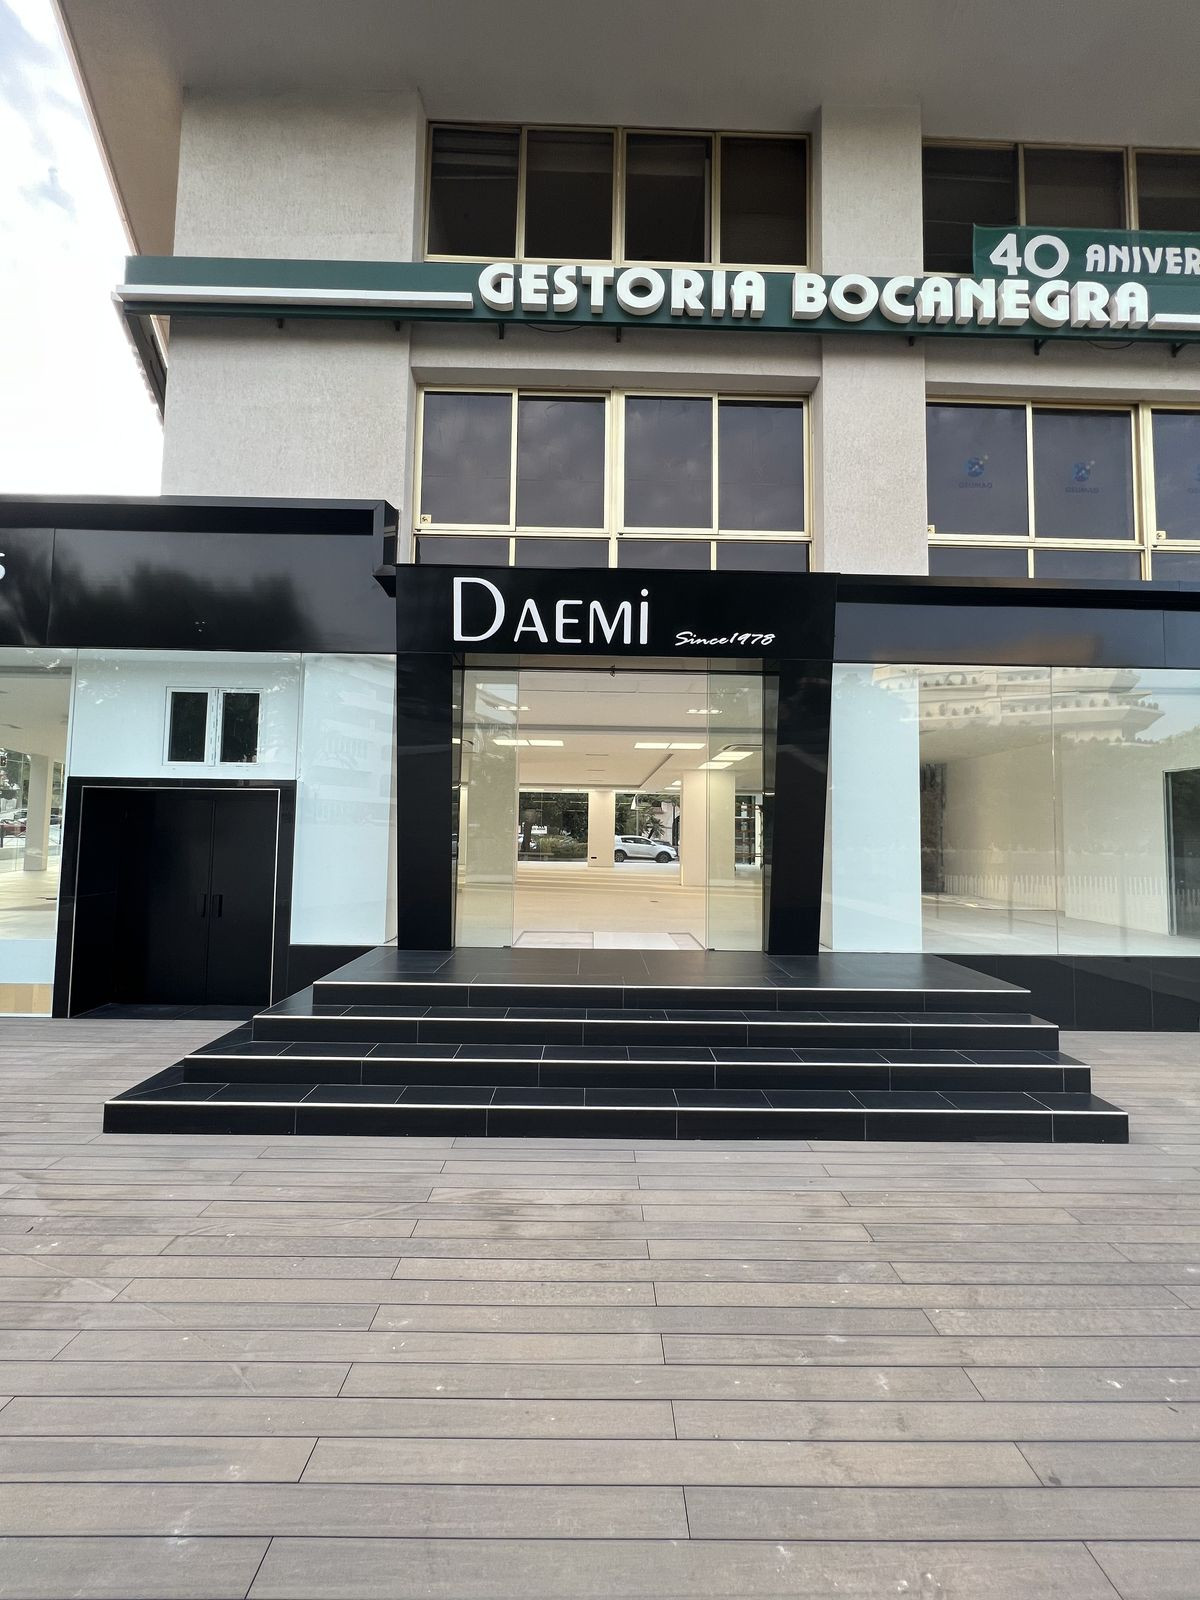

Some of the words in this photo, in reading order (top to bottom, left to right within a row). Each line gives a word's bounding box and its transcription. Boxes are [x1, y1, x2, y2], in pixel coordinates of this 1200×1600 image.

[989, 233, 1070, 279] 40
[1085, 244, 1200, 275] ANIVER
[478, 262, 766, 320] GESTORIA
[791, 272, 1149, 330] BOCANEGRA
